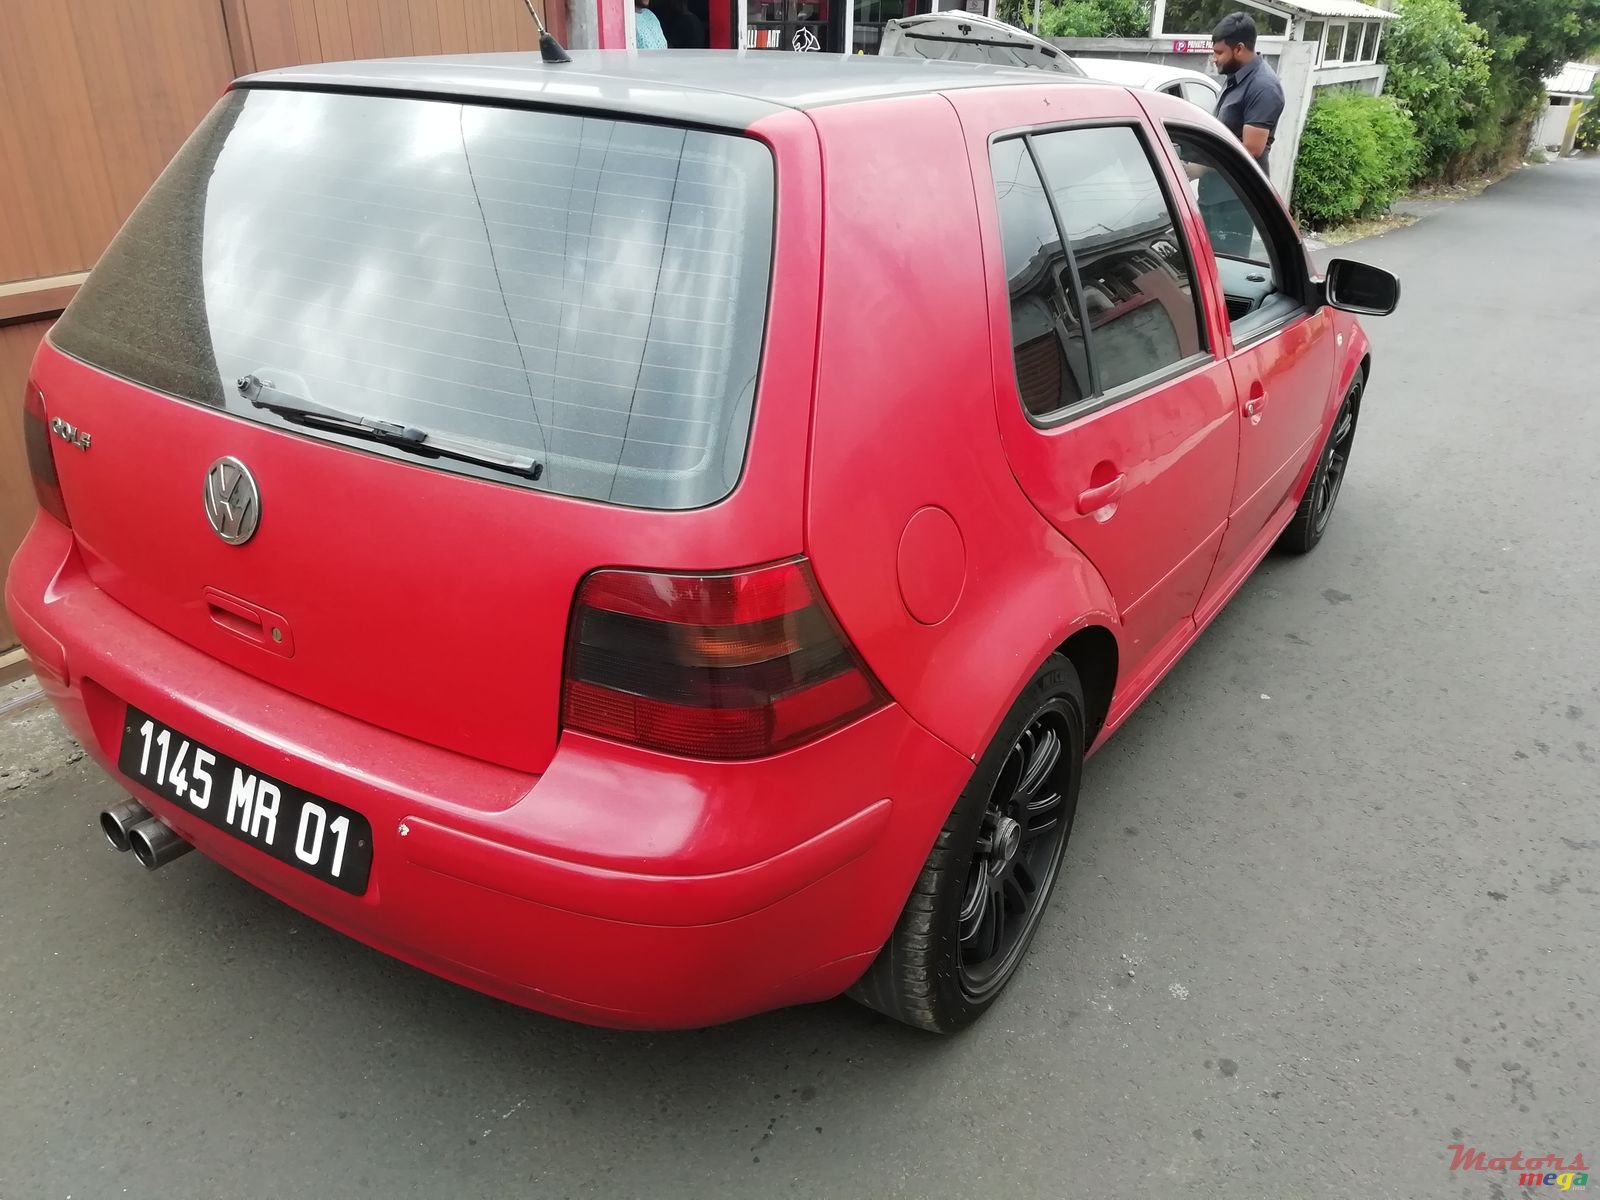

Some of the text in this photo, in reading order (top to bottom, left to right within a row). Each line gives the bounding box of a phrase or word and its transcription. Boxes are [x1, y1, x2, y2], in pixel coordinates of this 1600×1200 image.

[1187, 41, 1205, 49] PRIVATE
[51, 413, 92, 452] GOLF
[140, 719, 350, 878] 1145 MR 01
